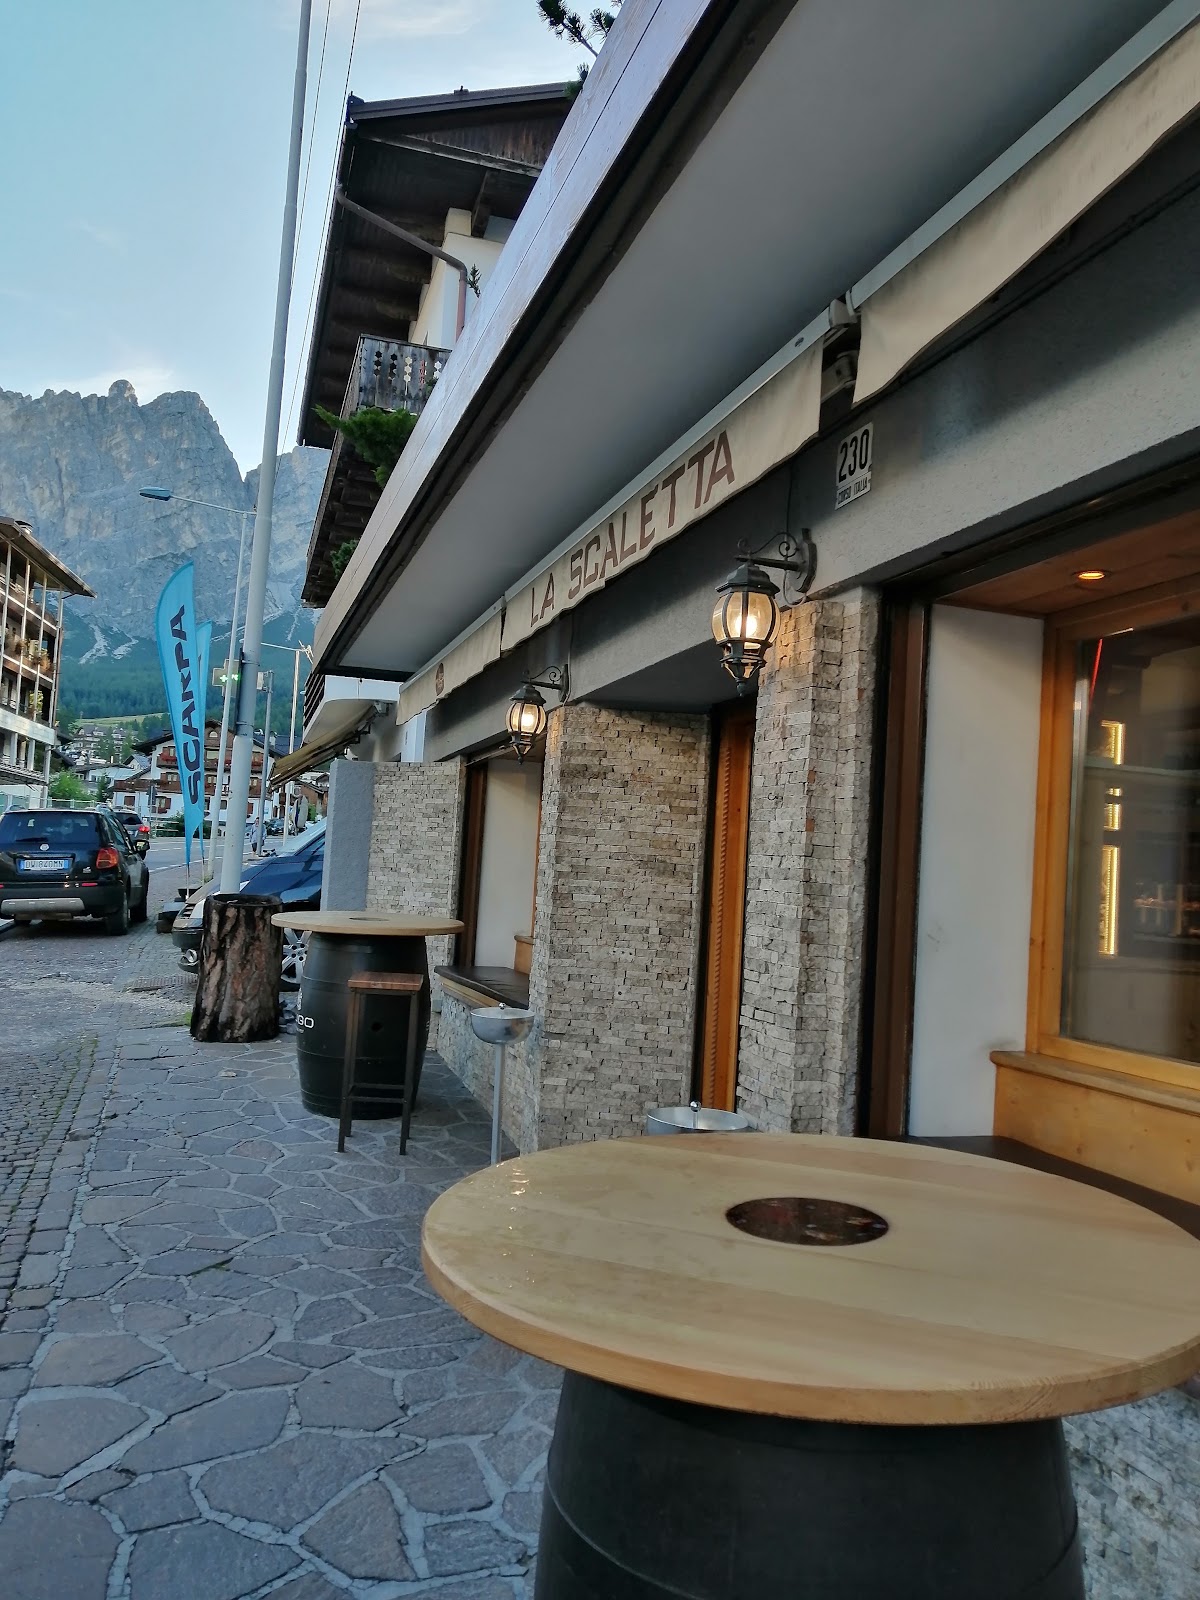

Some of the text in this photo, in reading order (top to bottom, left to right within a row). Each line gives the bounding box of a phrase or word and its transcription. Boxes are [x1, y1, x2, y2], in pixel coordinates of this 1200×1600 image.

[530, 430, 735, 628] LA SCALETTA
[838, 428, 870, 483] 230
[170, 604, 201, 805] SCARPA
